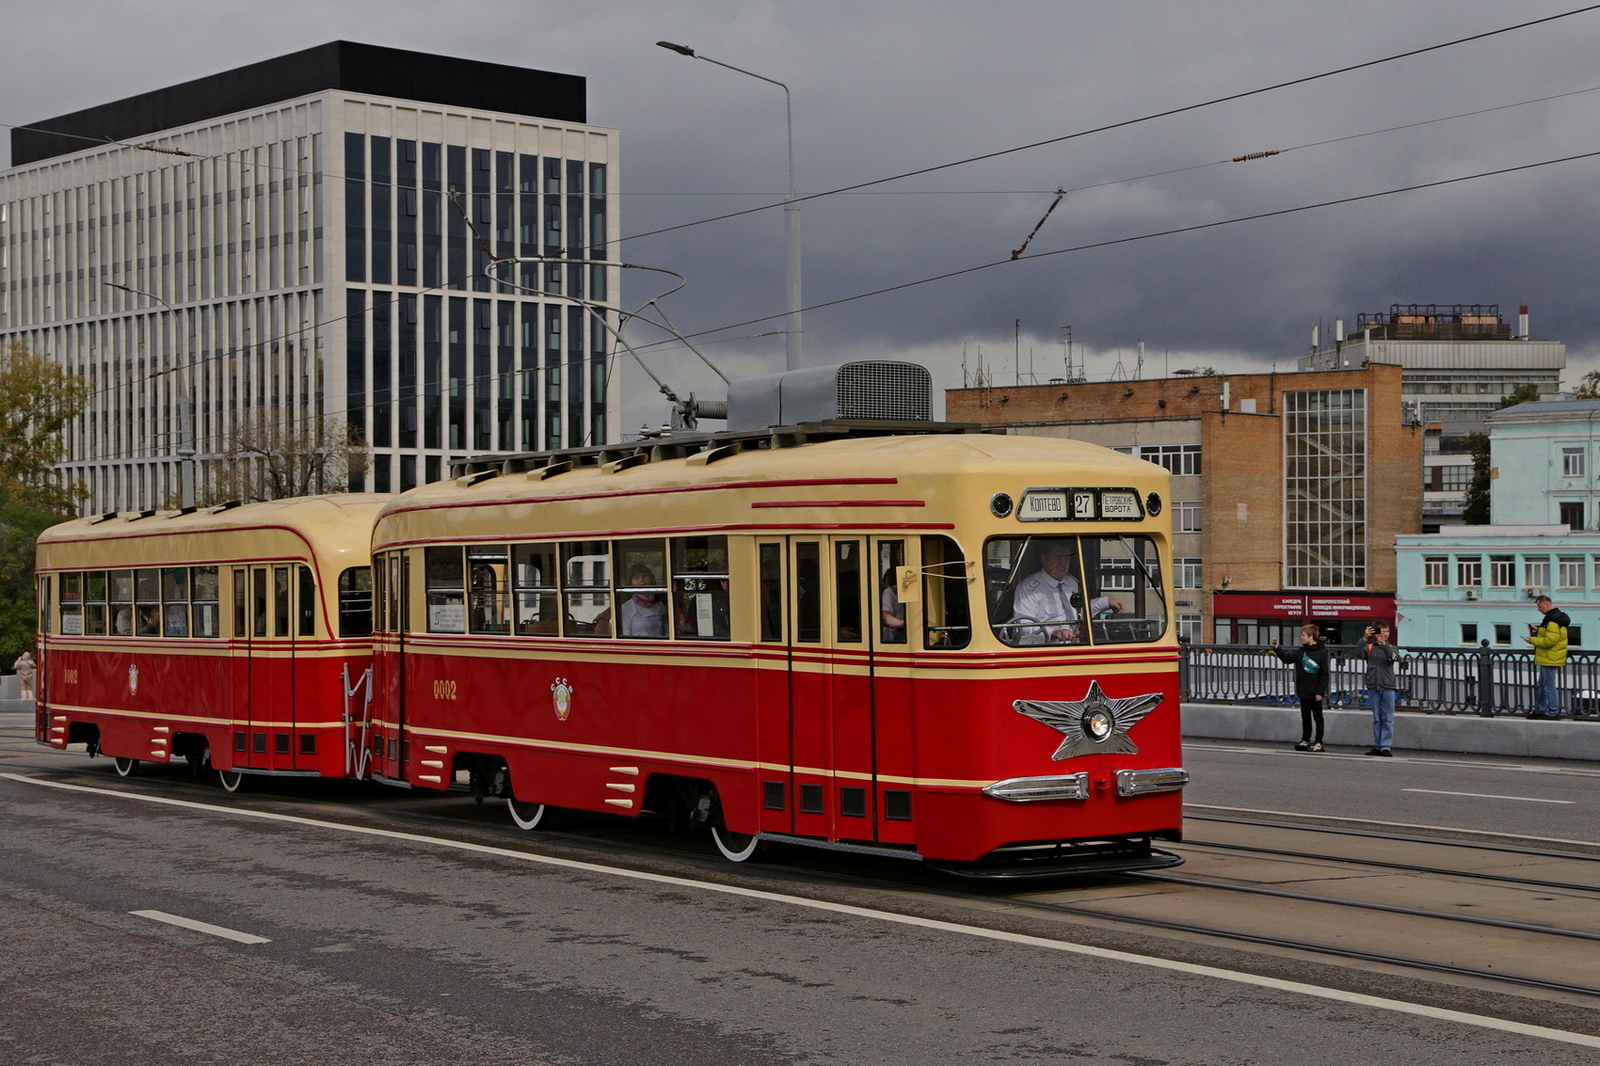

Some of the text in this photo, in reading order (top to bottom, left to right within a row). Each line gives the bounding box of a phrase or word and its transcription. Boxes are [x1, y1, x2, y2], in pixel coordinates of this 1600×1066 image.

[1075, 495, 1090, 513] 27
[1104, 505, 1131, 513] ВОРОТА
[433, 680, 457, 700] 0002
